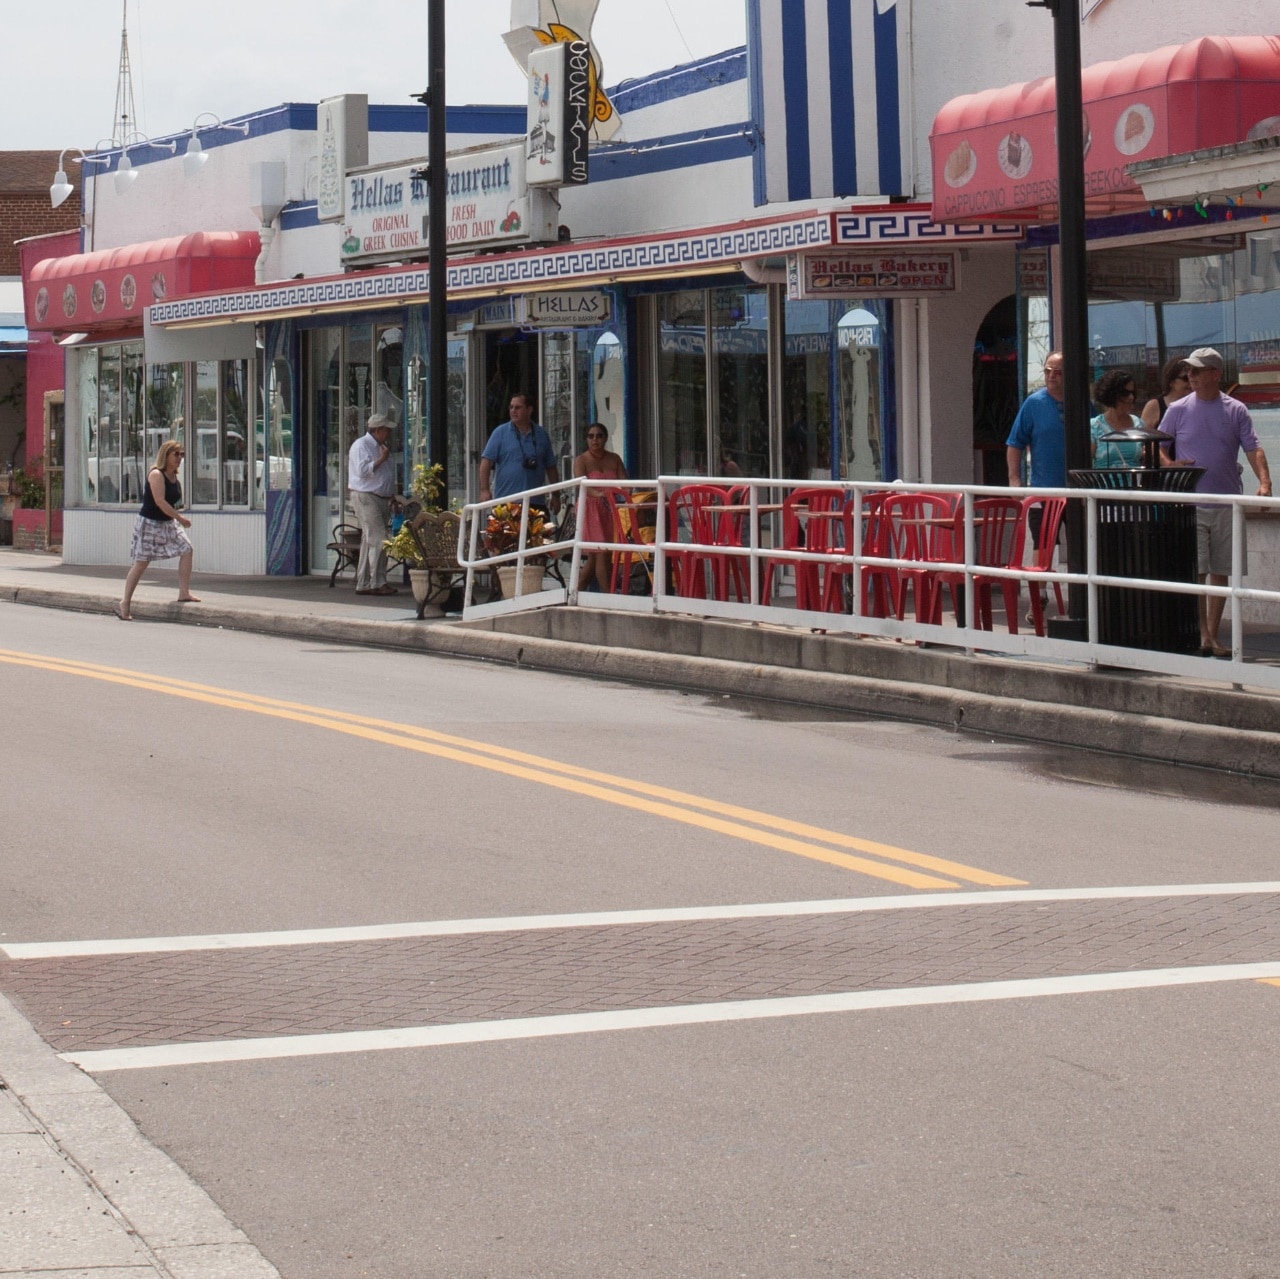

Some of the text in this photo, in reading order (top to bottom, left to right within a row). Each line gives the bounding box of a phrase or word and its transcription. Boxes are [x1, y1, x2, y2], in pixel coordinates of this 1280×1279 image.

[569, 40, 588, 182] COCKTAILS
[350, 176, 404, 211] Hellas
[944, 187, 1006, 215] CAPPUCCINO
[1013, 178, 1058, 205] ESPRESS
[1084, 169, 1111, 194] REEK
[372, 204, 477, 233] ORIGINAL FRESH
[363, 235, 387, 252] GREEK
[390, 231, 419, 247] CUISINE
[472, 220, 496, 239] DAILY
[811, 258, 949, 275] Hellas Bakery
[900, 275, 945, 286] OPEN
[538, 296, 599, 313] HELLAS
